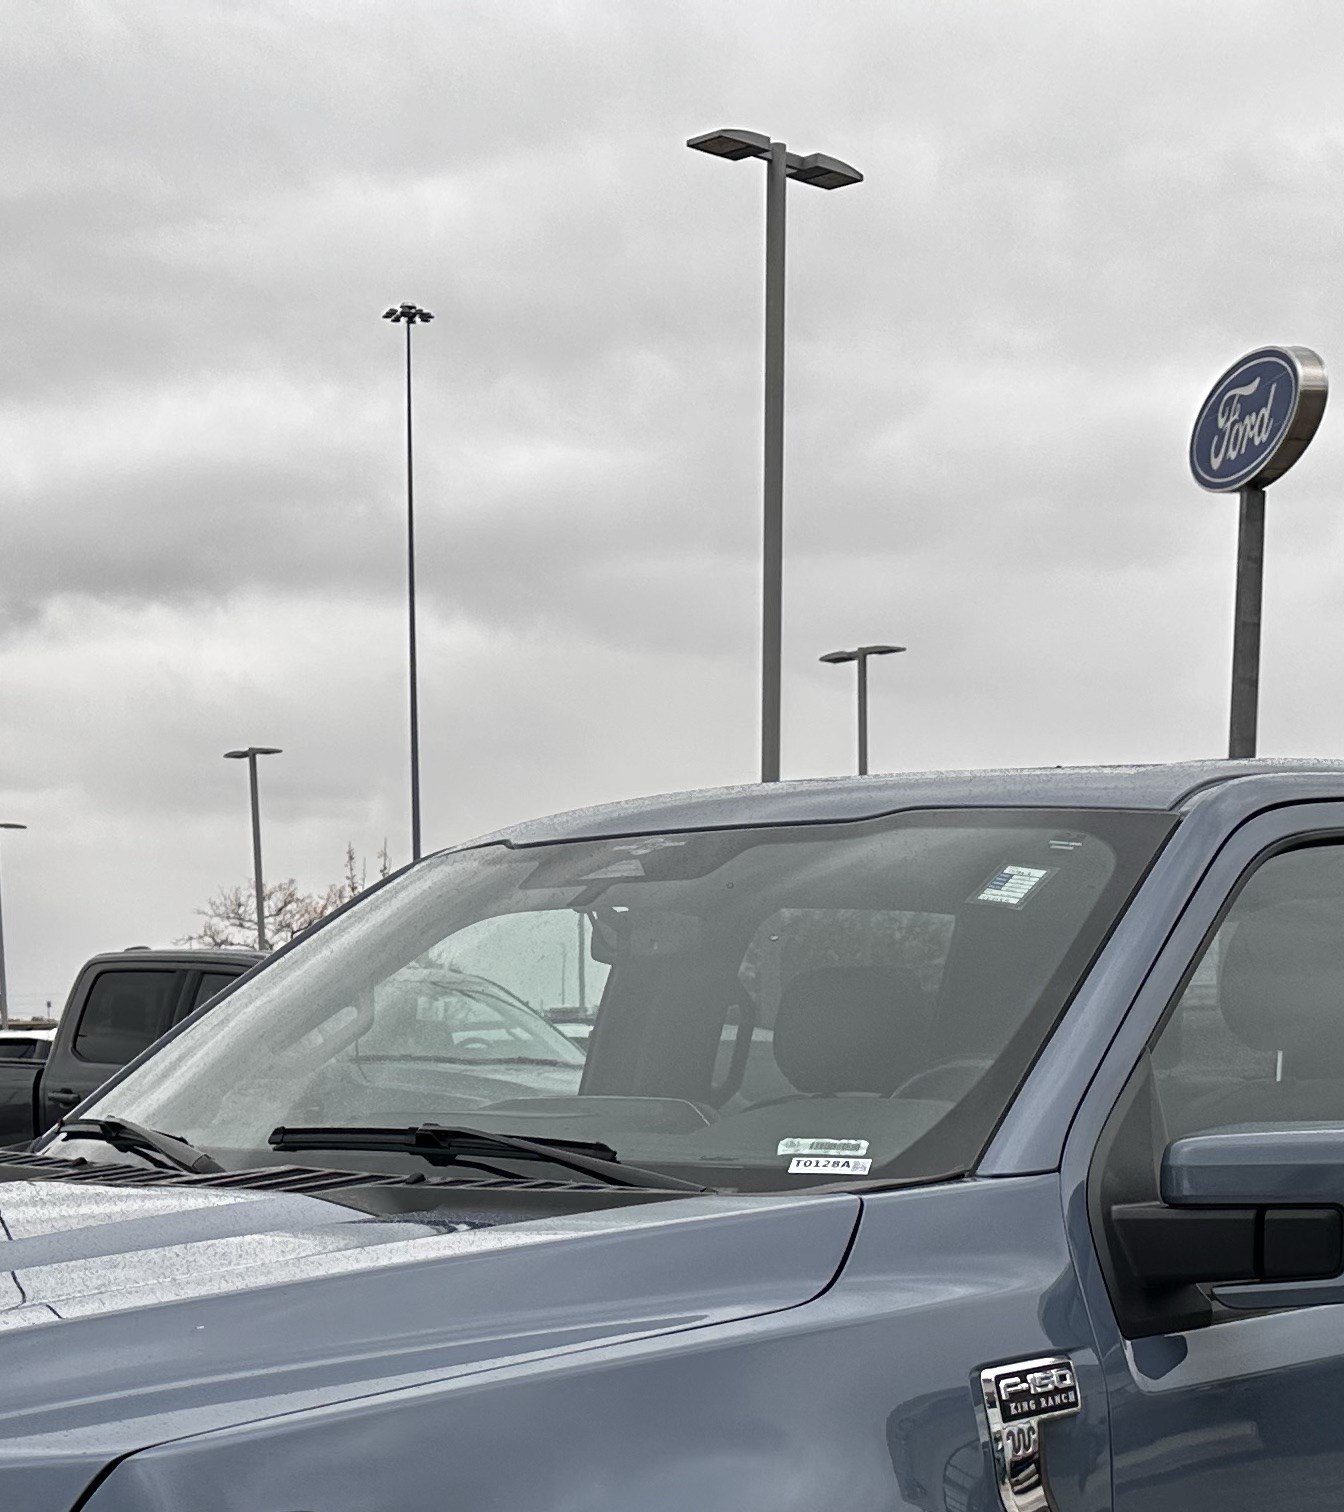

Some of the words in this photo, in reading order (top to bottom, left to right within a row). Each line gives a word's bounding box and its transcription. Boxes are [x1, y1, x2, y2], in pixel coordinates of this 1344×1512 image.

[1210, 377, 1277, 471] Ford
[999, 1368, 1075, 1400] F-150
[1010, 1401, 1036, 1415] KING
[1040, 1390, 1076, 1408] RANCH
